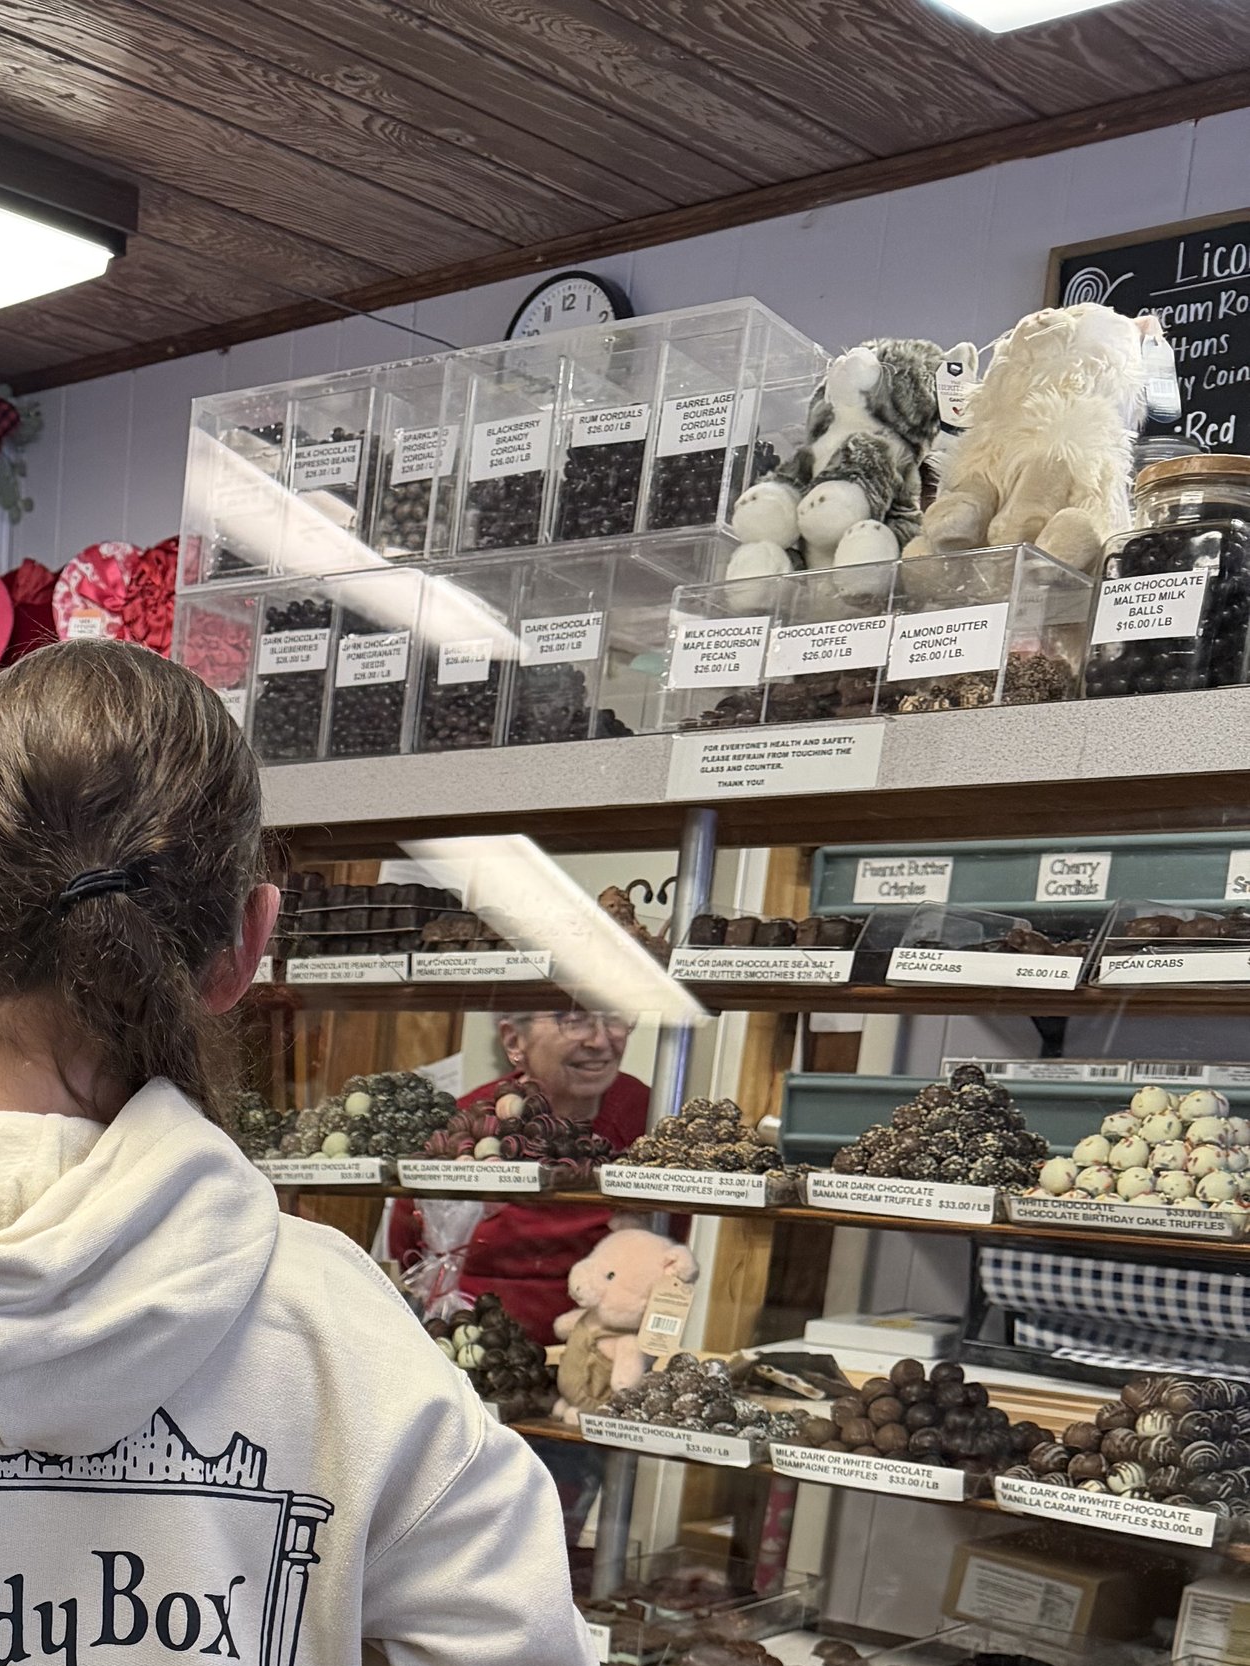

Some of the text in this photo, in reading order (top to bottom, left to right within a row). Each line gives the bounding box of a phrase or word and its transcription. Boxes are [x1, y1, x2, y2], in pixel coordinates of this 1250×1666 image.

[1175, 241, 1250, 283] Lico
[562, 293, 576, 312] 12
[586, 295, 592, 312] 1
[675, 396, 711, 410] BARREL
[579, 409, 643, 424] RUM CORDIALS
[682, 406, 727, 420] BOURBAN
[486, 420, 541, 436] BLACKBERRY
[681, 417, 726, 432] CORDIALS
[1185, 411, 1236, 446] Red
[495, 432, 529, 446] BRANDY
[490, 442, 532, 456] CORDIALS
[1103, 576, 1204, 596] DARK CHOCOLATE
[1114, 590, 1186, 606] MALTED MILK
[1128, 604, 1164, 617] BALLS
[684, 625, 764, 638] MILK CHOCOLATE
[777, 620, 886, 640] CHOCOLATE COVERED
[900, 620, 988, 639] ALMOND BUTTER
[682, 638, 760, 650] MAPLE BOURBON
[810, 636, 848, 648] TOFFEE
[913, 636, 957, 650] CRUNCH
[700, 652, 736, 661] PECANS
[720, 742, 768, 751] EVERYONE'S
[770, 740, 802, 748] HEALTH
[803, 738, 820, 746] AND
[822, 736, 856, 744] SAFETY,
[701, 754, 730, 763] PLEASE
[732, 752, 765, 761] REFRAIN
[766, 751, 790, 759] FROM
[792, 748, 833, 758] TOUCHING
[700, 765, 724, 774] GLASS
[718, 779, 744, 788] THANK
[862, 860, 948, 878] Peanut Butter
[1050, 858, 1101, 878] Cherry
[878, 882, 926, 898] Crispies
[1044, 879, 1099, 896] Cordials
[899, 950, 943, 960] SEA SALT
[895, 962, 962, 974] PECAN CRABS
[1108, 958, 1184, 970] PECAN CRABS
[813, 1179, 934, 1196] MILK OR DARK CHOCOLATE
[812, 1190, 882, 1202] BANANA CREAM
[1017, 1208, 1225, 1231] CHOCOLATE BIRTHDAY CAKE TRUFFLES
[775, 1448, 933, 1478] MILK, DARK OR WHITE CHOCOLATE
[776, 1458, 878, 1481] CHAMPAGNE TRUFFLES
[1000, 1492, 1042, 1508] VANILLA
[1044, 1500, 1092, 1517] CARAMEL
[1094, 1509, 1148, 1527] TRUFFLES
[1030, 1486, 1058, 1499] DARK
[1060, 1492, 1076, 1502] OR
[1078, 1494, 1121, 1510] WWHITE
[1123, 1502, 1191, 1522] CHOCOLATE
[90, 1550, 247, 1660] Box
